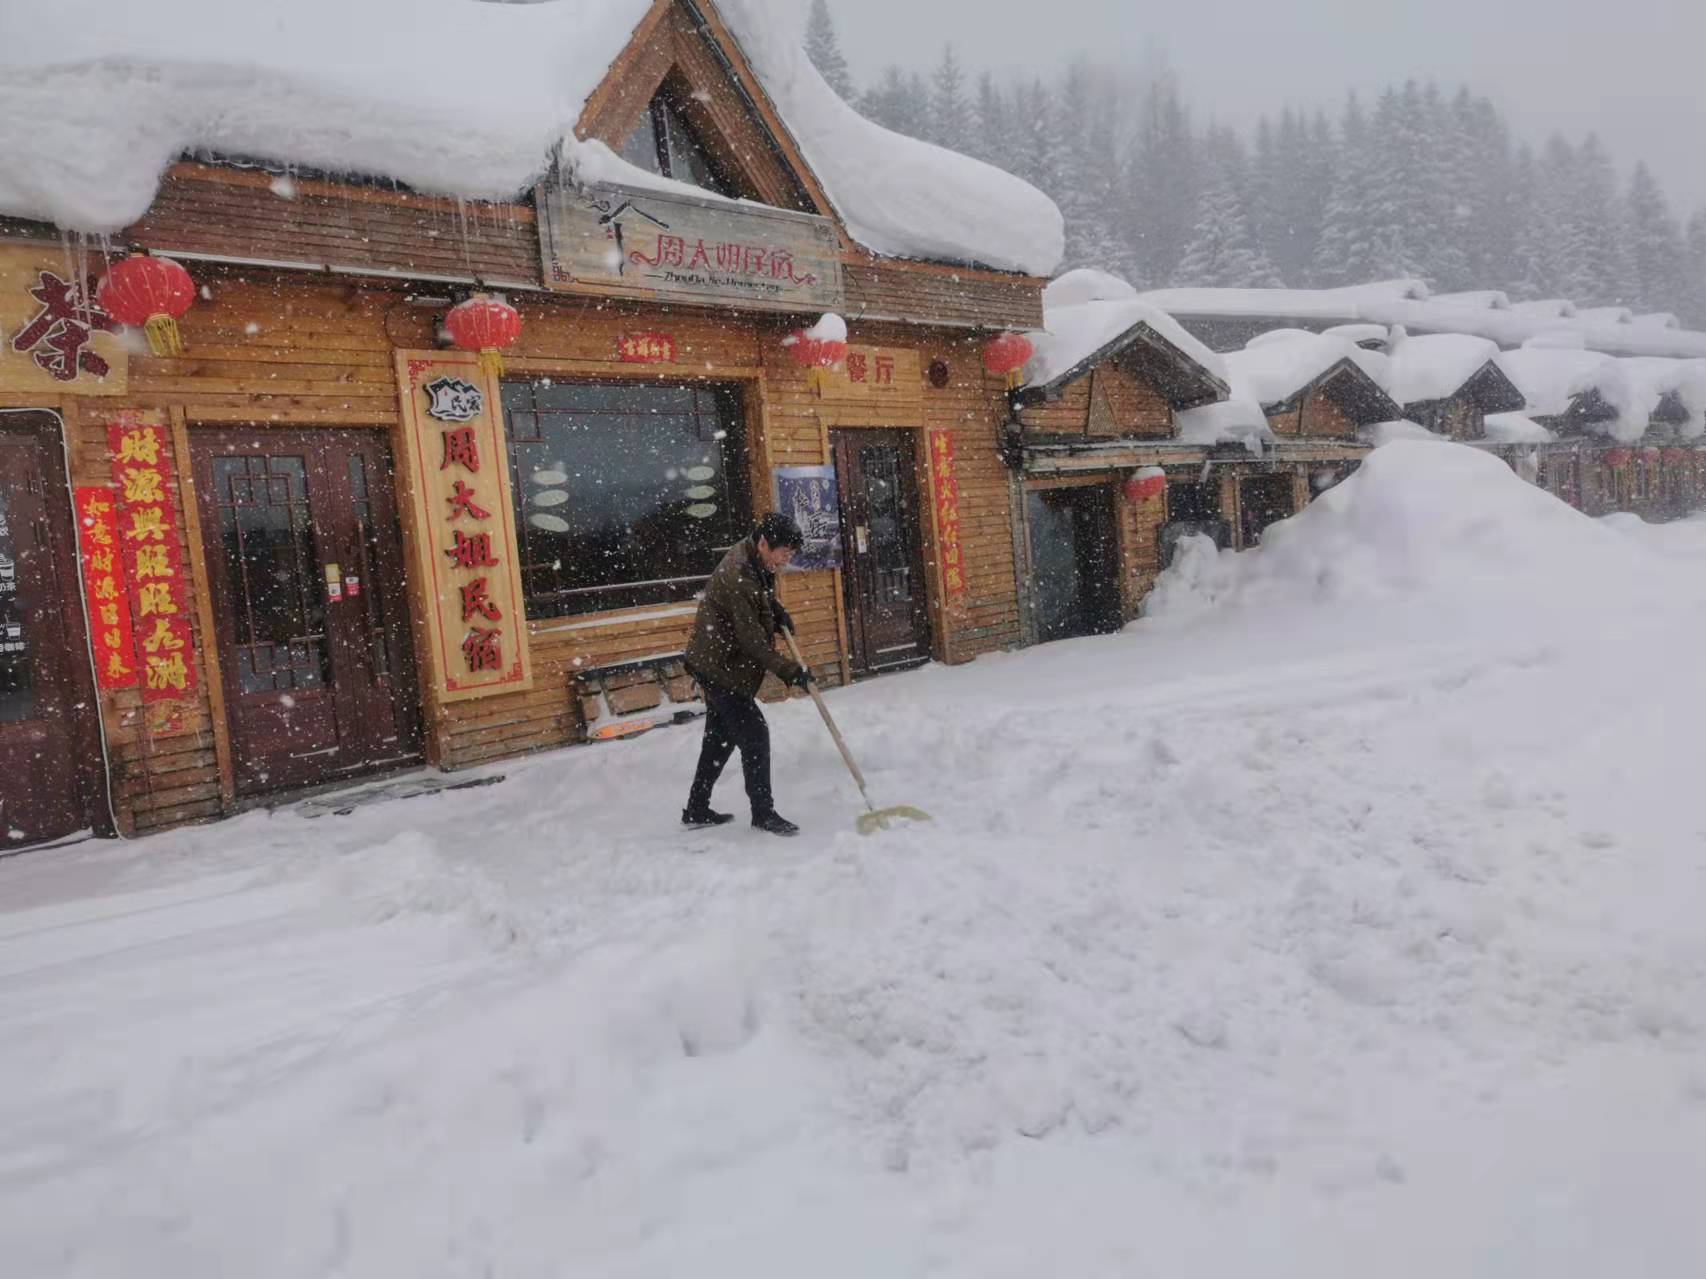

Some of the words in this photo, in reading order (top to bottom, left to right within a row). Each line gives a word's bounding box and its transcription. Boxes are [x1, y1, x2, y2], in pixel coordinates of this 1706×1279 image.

[632, 234, 814, 284] 周大姐民宿
[10, 269, 117, 381] 茶
[847, 352, 893, 384] 餐厅
[440, 426, 502, 673] 周大姐民宿
